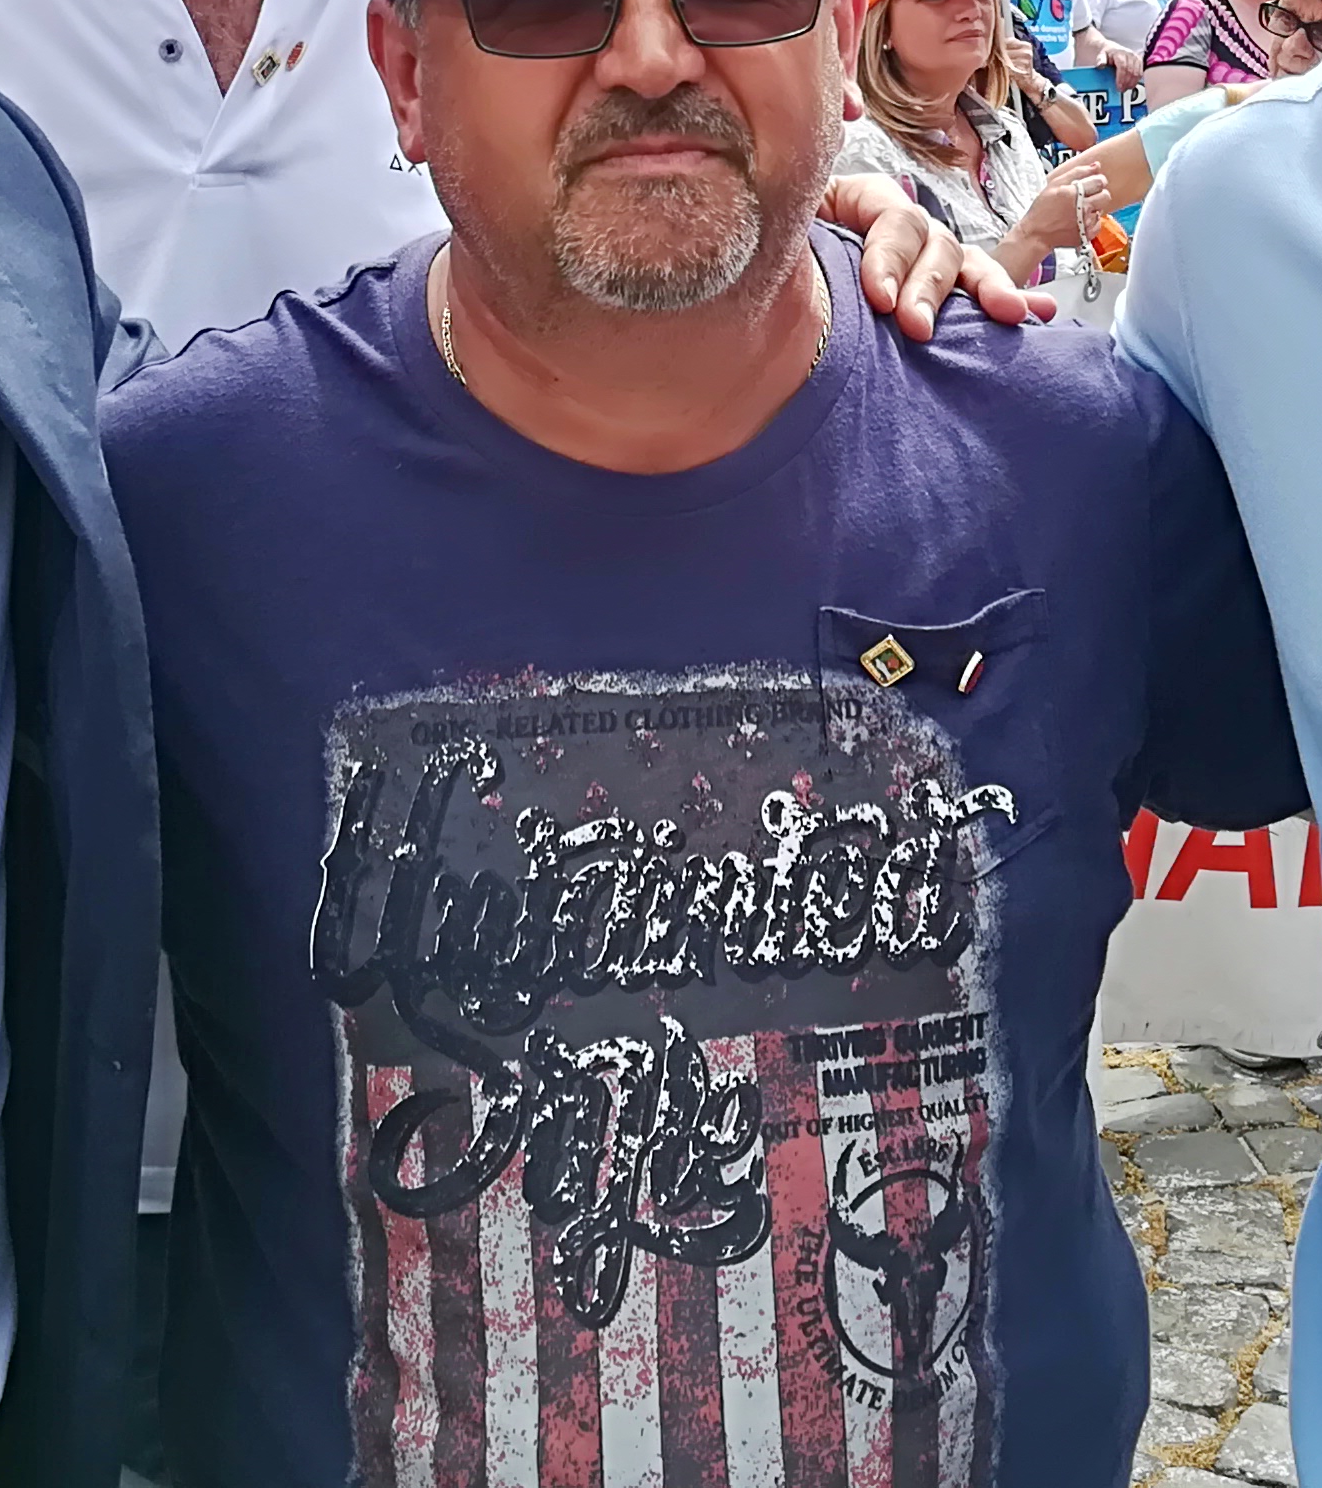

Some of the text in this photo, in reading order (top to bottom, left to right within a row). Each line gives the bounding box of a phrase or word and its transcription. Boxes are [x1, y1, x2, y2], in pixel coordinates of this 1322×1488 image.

[761, 1092, 990, 1140] OUT OF HIGHEST QUALITY
[796, 1295, 887, 1411] ULTIMATE
